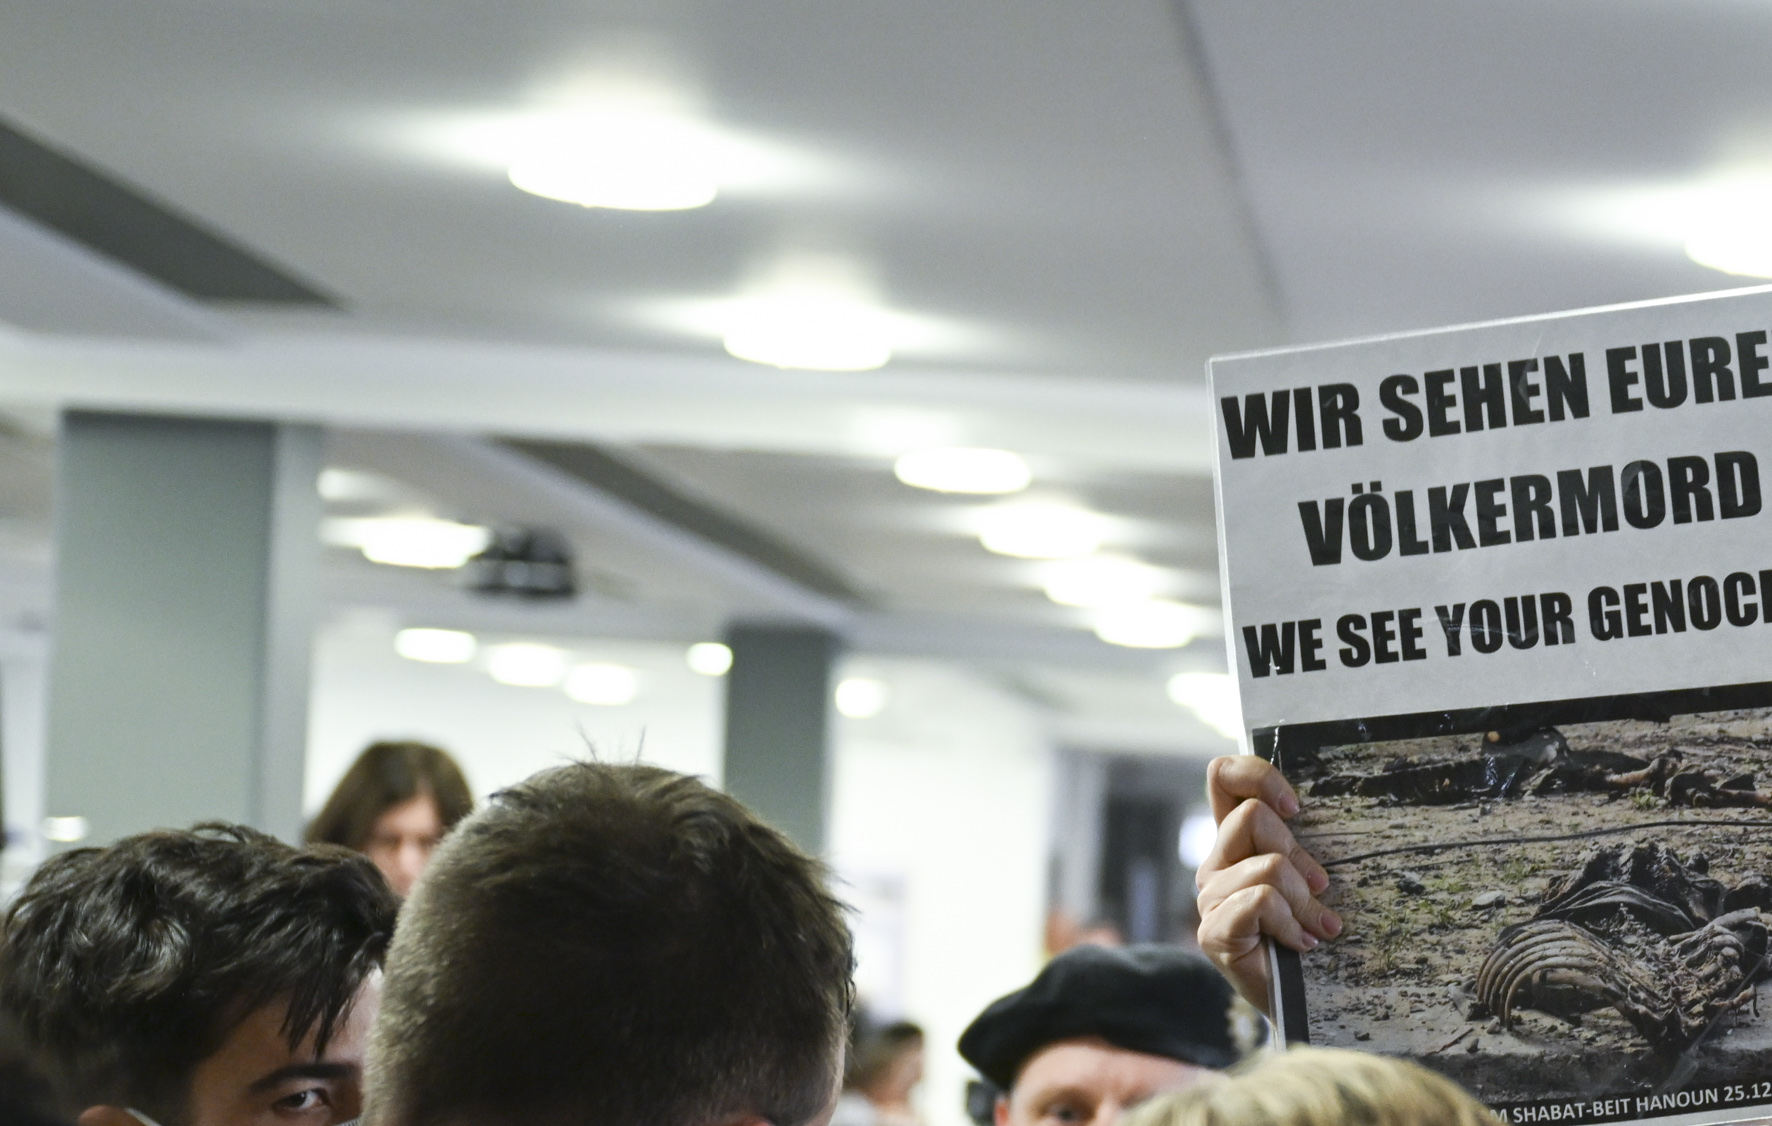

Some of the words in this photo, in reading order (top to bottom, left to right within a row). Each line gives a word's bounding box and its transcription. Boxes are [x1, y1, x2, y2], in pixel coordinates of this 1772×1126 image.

[1220, 382, 1364, 460] WIR
[1378, 352, 1590, 443] SEHEN
[1297, 450, 1763, 567] VÖLKERMORD
[1242, 618, 1326, 679] WE
[1336, 606, 1427, 669] SEE
[1435, 591, 1577, 658] YOUR
[1512, 1098, 1631, 1124] SHABAT-BEIT
[1635, 1087, 1719, 1113] HANOUN
